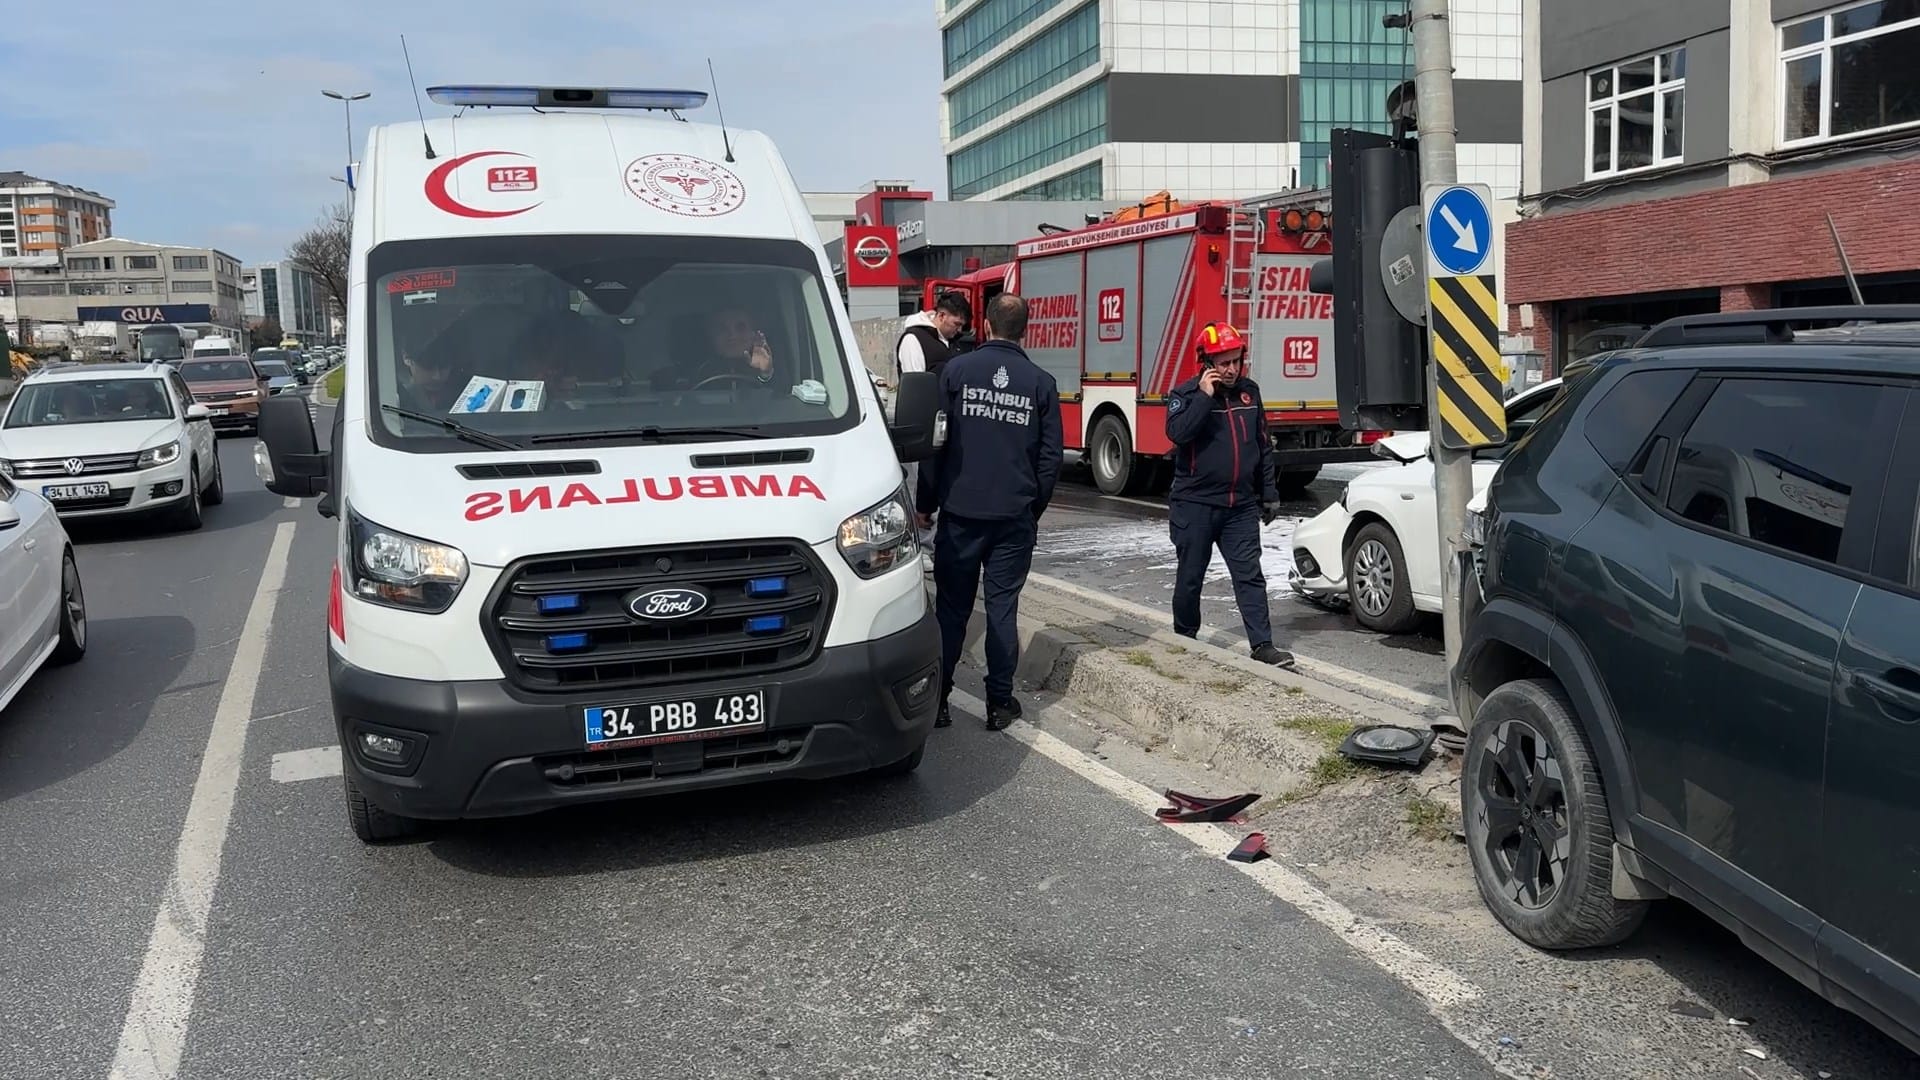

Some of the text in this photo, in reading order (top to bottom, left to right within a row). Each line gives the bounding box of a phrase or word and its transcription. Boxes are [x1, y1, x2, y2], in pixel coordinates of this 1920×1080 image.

[495, 169, 529, 182] 112
[1037, 219, 1169, 251] İSTANBUL BÜYÜKŞEHİR BELEDİYESİ
[121, 307, 165, 322] QUA
[1027, 294, 1078, 319] STANBUL
[1103, 295, 1120, 319] 112
[1257, 294, 1335, 319] İTFAİYE
[1289, 340, 1313, 359] 112
[962, 384, 1034, 410] İSTANBUL
[962, 400, 1031, 426] İTFAİYESİ
[50, 485, 106, 498] 34 LK 1432
[645, 593, 692, 613] Ford
[603, 694, 759, 737] 34 PBB 483
[589, 728, 602, 736] TR
